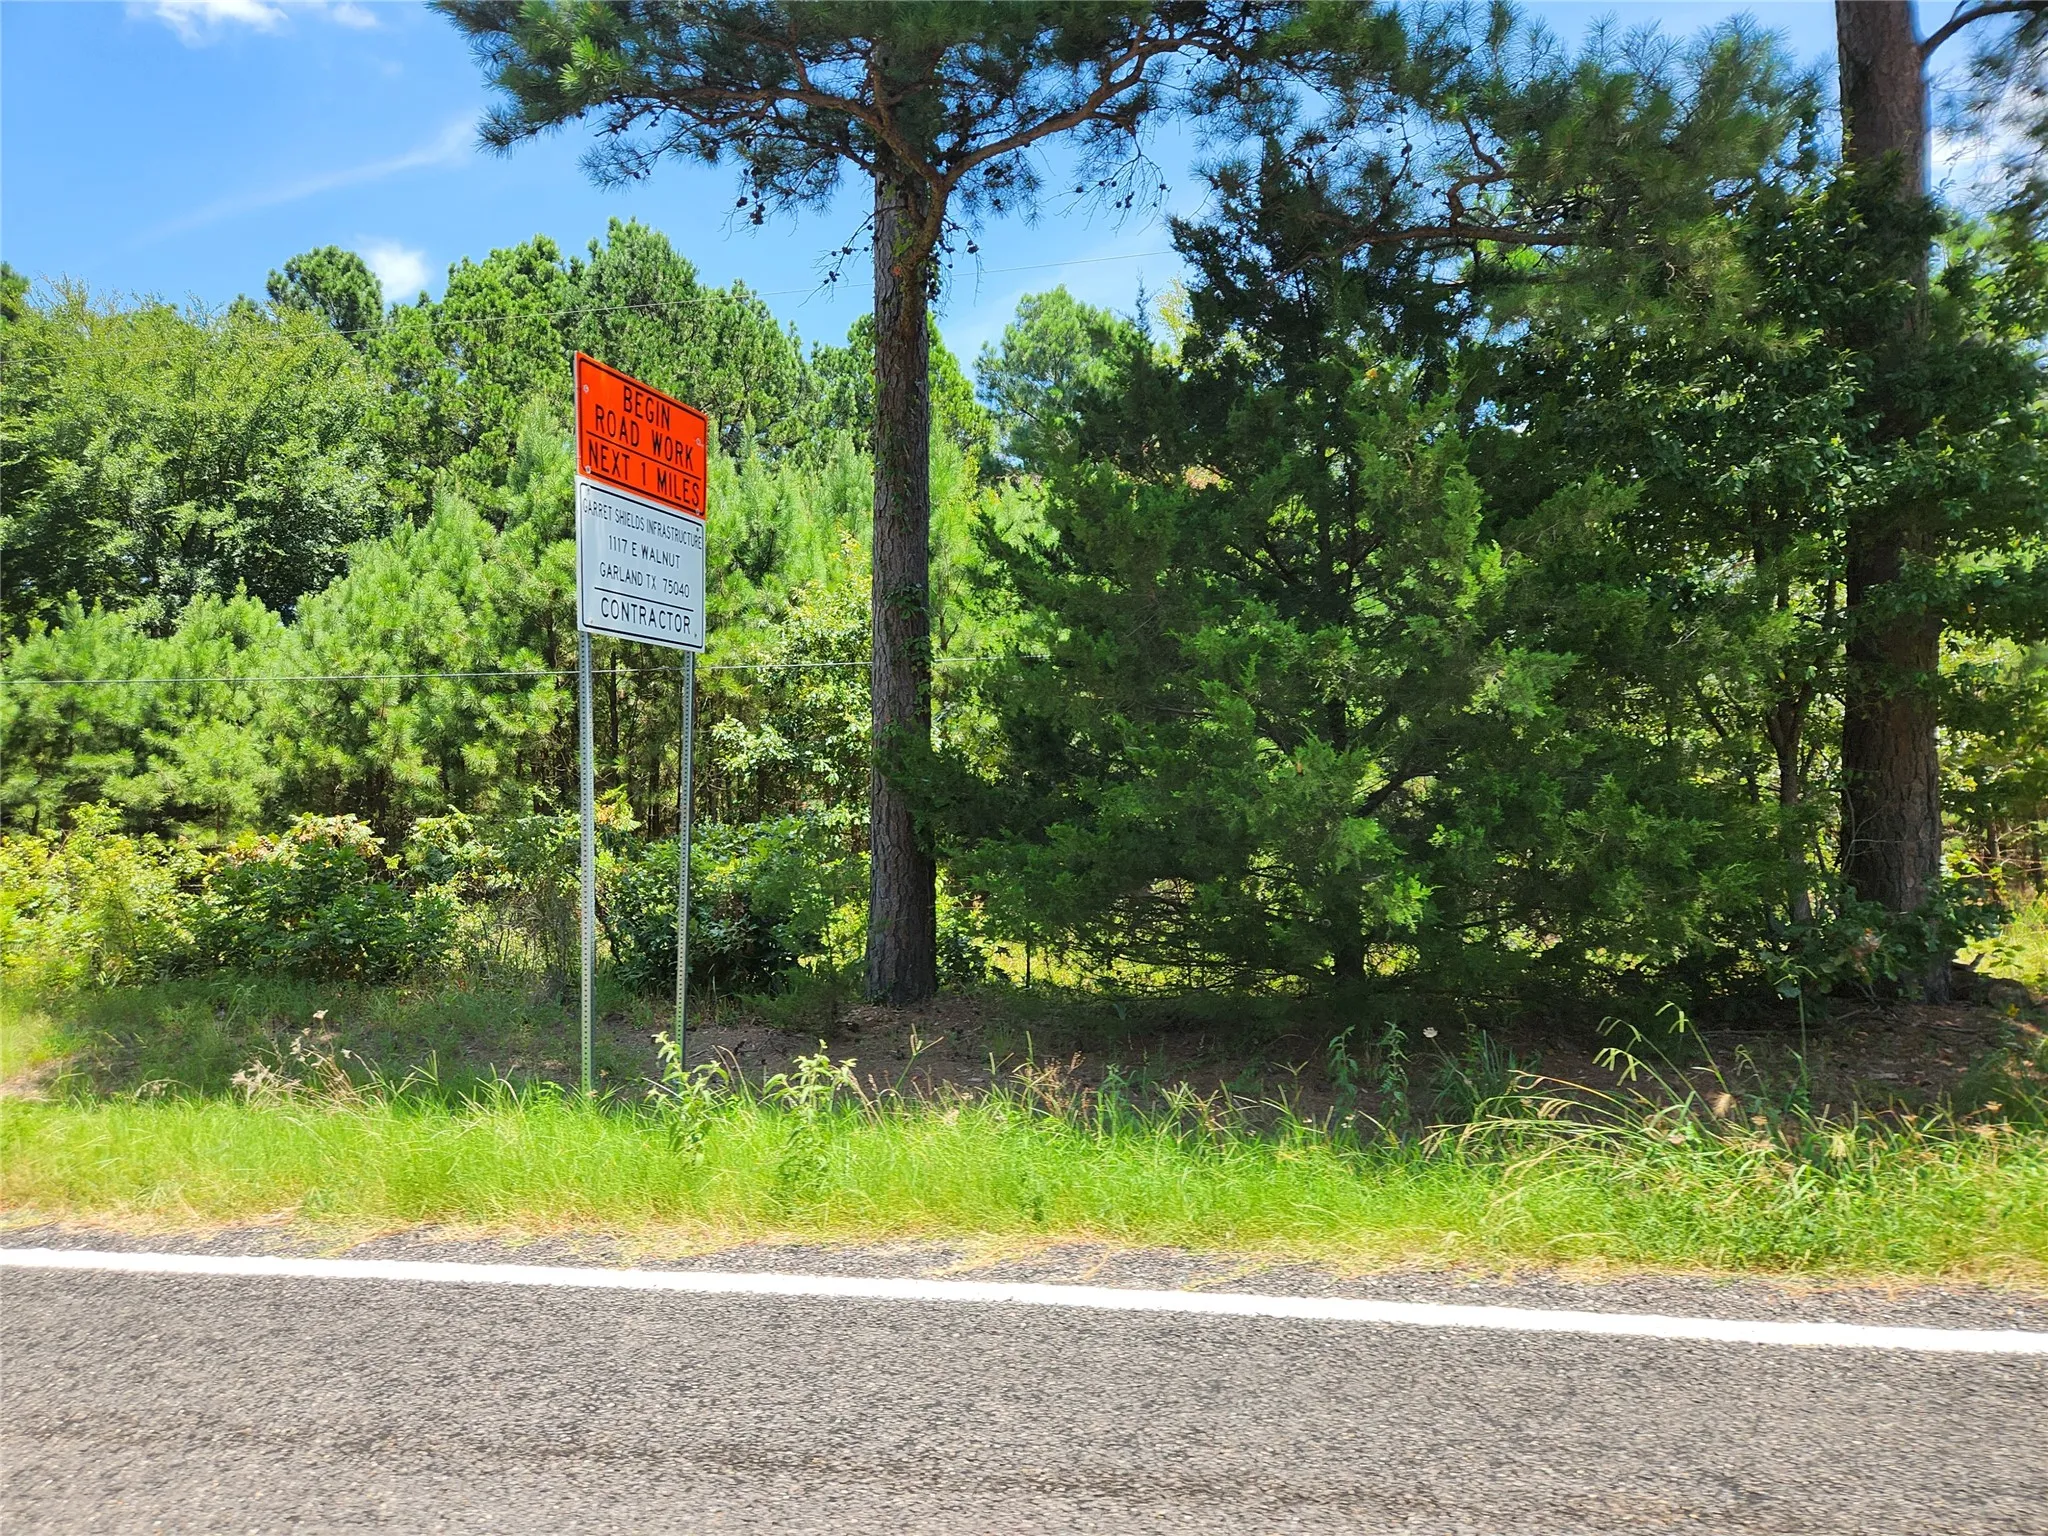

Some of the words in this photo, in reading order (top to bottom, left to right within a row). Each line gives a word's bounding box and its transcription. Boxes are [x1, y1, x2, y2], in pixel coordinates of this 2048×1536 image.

[623, 385, 671, 432] BEGIN
[595, 403, 640, 448] ROAD
[651, 429, 694, 471] WORK
[588, 439, 630, 480] NEXT
[641, 462, 647, 486] 1
[657, 468, 699, 507] MILES
[583, 498, 612, 521] GARRET
[615, 508, 645, 531] SHIELDS
[646, 518, 702, 550] INFRASTRUCTURE
[608, 535, 628, 554] 1117
[632, 542, 638, 557] E
[641, 544, 681, 569] WALNUT
[599, 561, 643, 587] GARLAND
[646, 573, 657, 591] TX
[662, 578, 690, 599] 75040
[600, 597, 691, 635] CONTRACTOR
